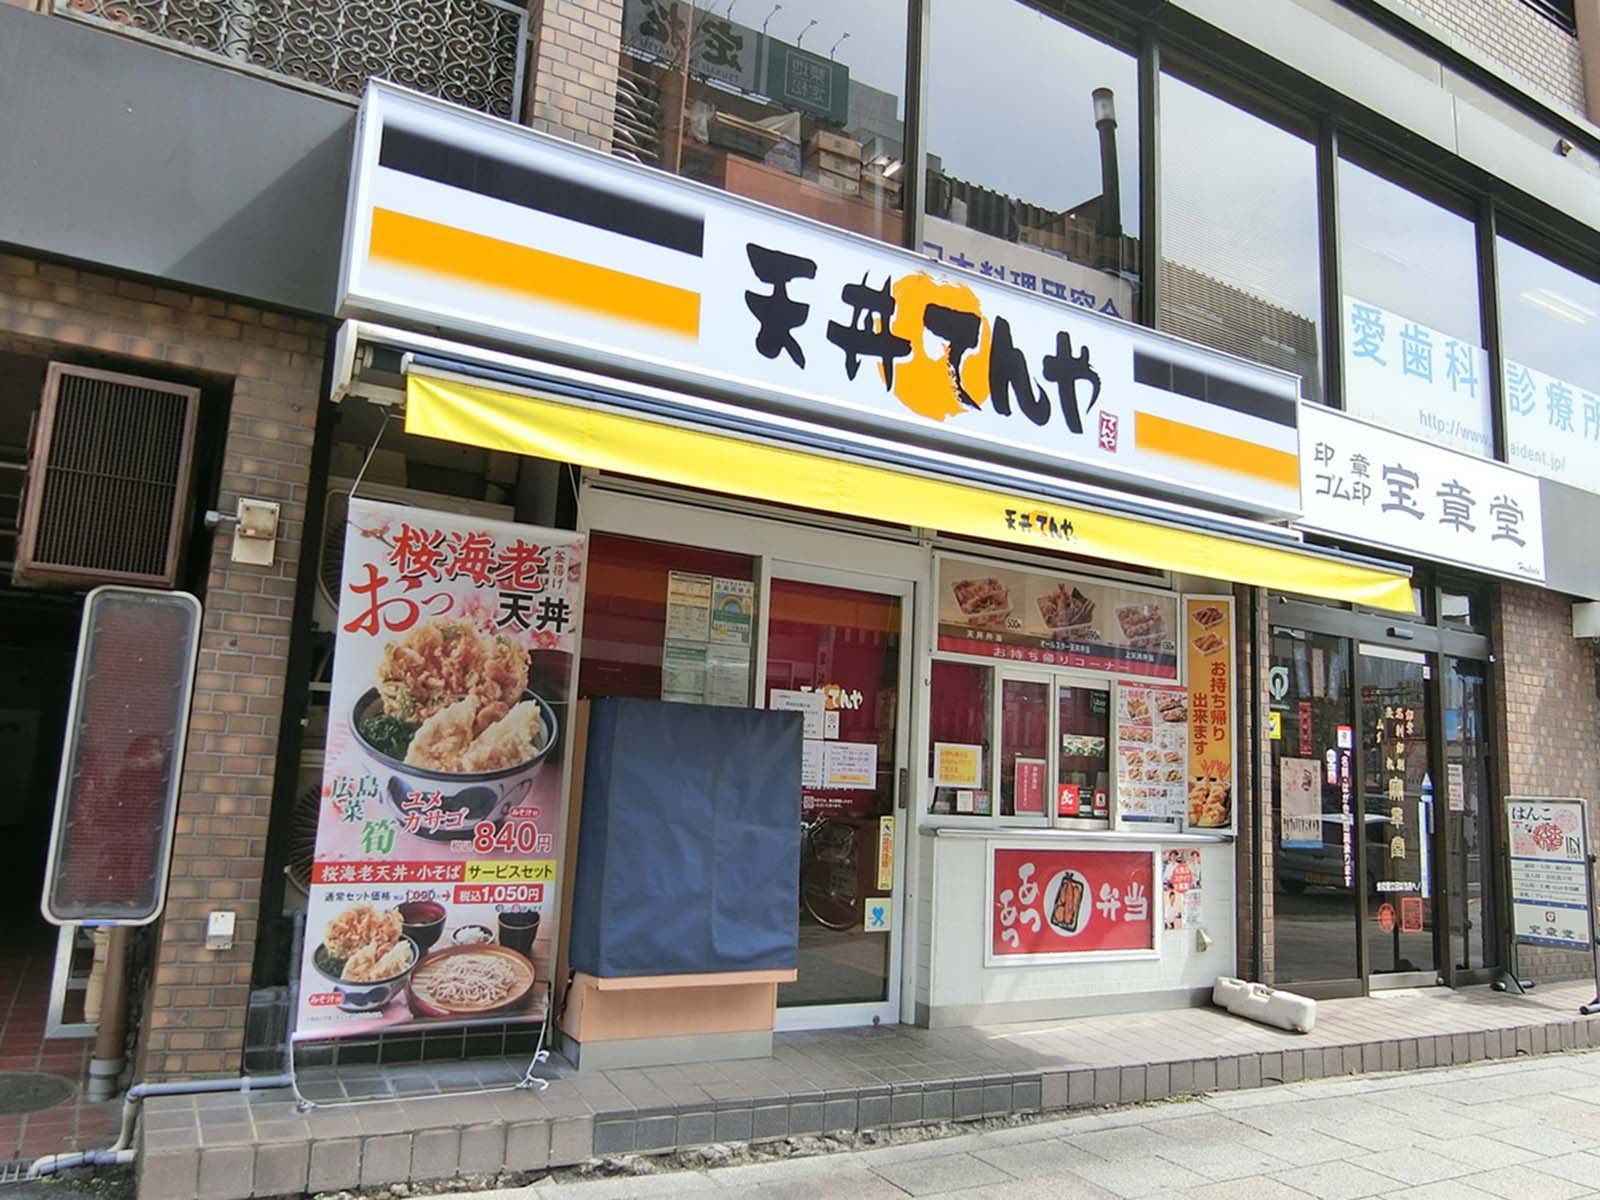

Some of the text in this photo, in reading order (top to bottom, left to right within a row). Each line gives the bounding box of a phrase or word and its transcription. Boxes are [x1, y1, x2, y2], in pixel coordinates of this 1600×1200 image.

[745, 243, 1102, 434] 天丼てんや
[1004, 509, 1074, 541] 天丼てんや
[1381, 463, 1526, 549] 宝章堂
[388, 522, 549, 594] 桜海老
[496, 591, 570, 633] 天丼
[1211, 661, 1227, 742] お持ち帰り
[1193, 693, 1207, 756] 出来ます
[402, 789, 443, 809] ユメ
[1511, 806, 1552, 821] はんこ
[402, 807, 470, 834] カサゴ
[468, 864, 553, 881] サービスセット
[1096, 881, 1148, 922] 弁当
